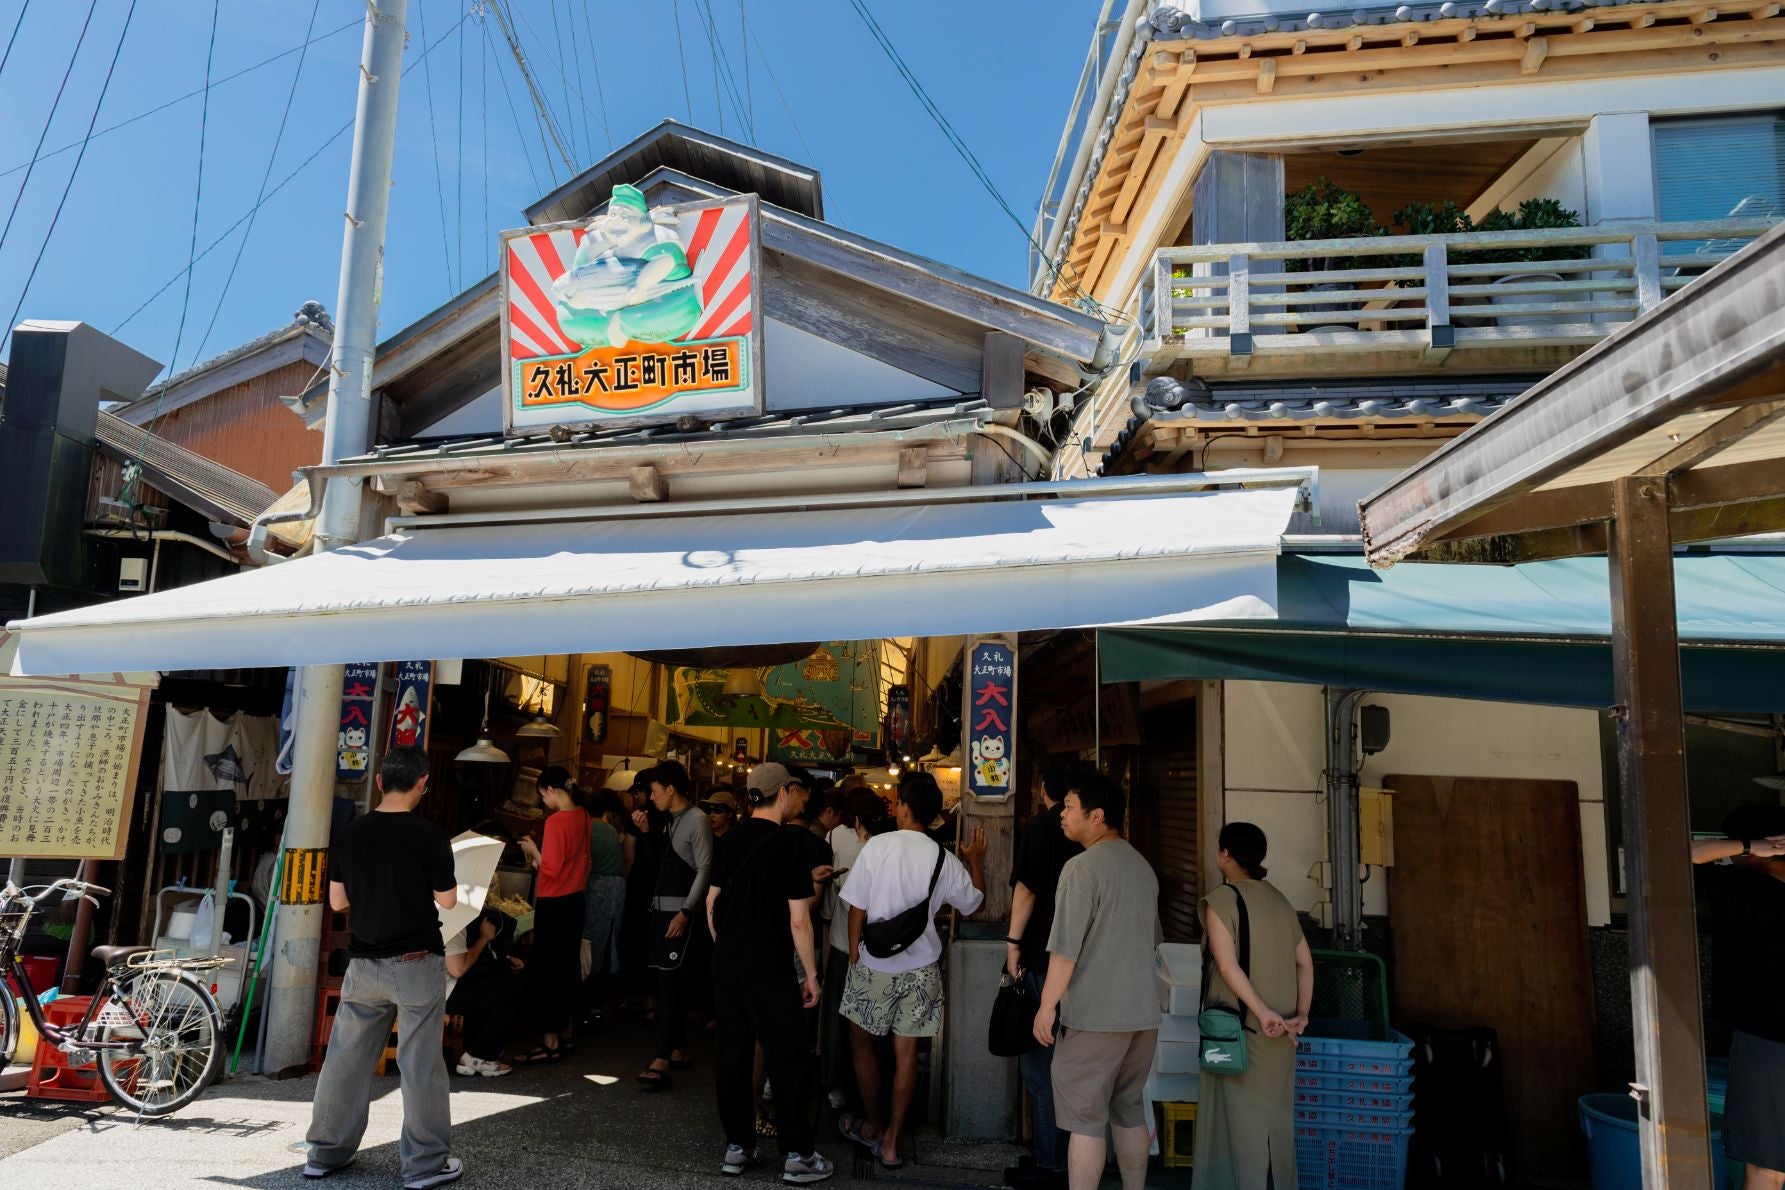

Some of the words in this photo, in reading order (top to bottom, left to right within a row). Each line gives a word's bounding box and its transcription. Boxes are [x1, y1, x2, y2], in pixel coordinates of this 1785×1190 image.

[527, 347, 730, 400] 久礼大正町市場
[982, 651, 1003, 661] 久礼
[345, 669, 376, 679] 大正町市場
[398, 672, 429, 682] 大正町市場
[973, 664, 1012, 677] 大正町市場
[341, 681, 371, 725] 大入
[975, 681, 1008, 731] 大入
